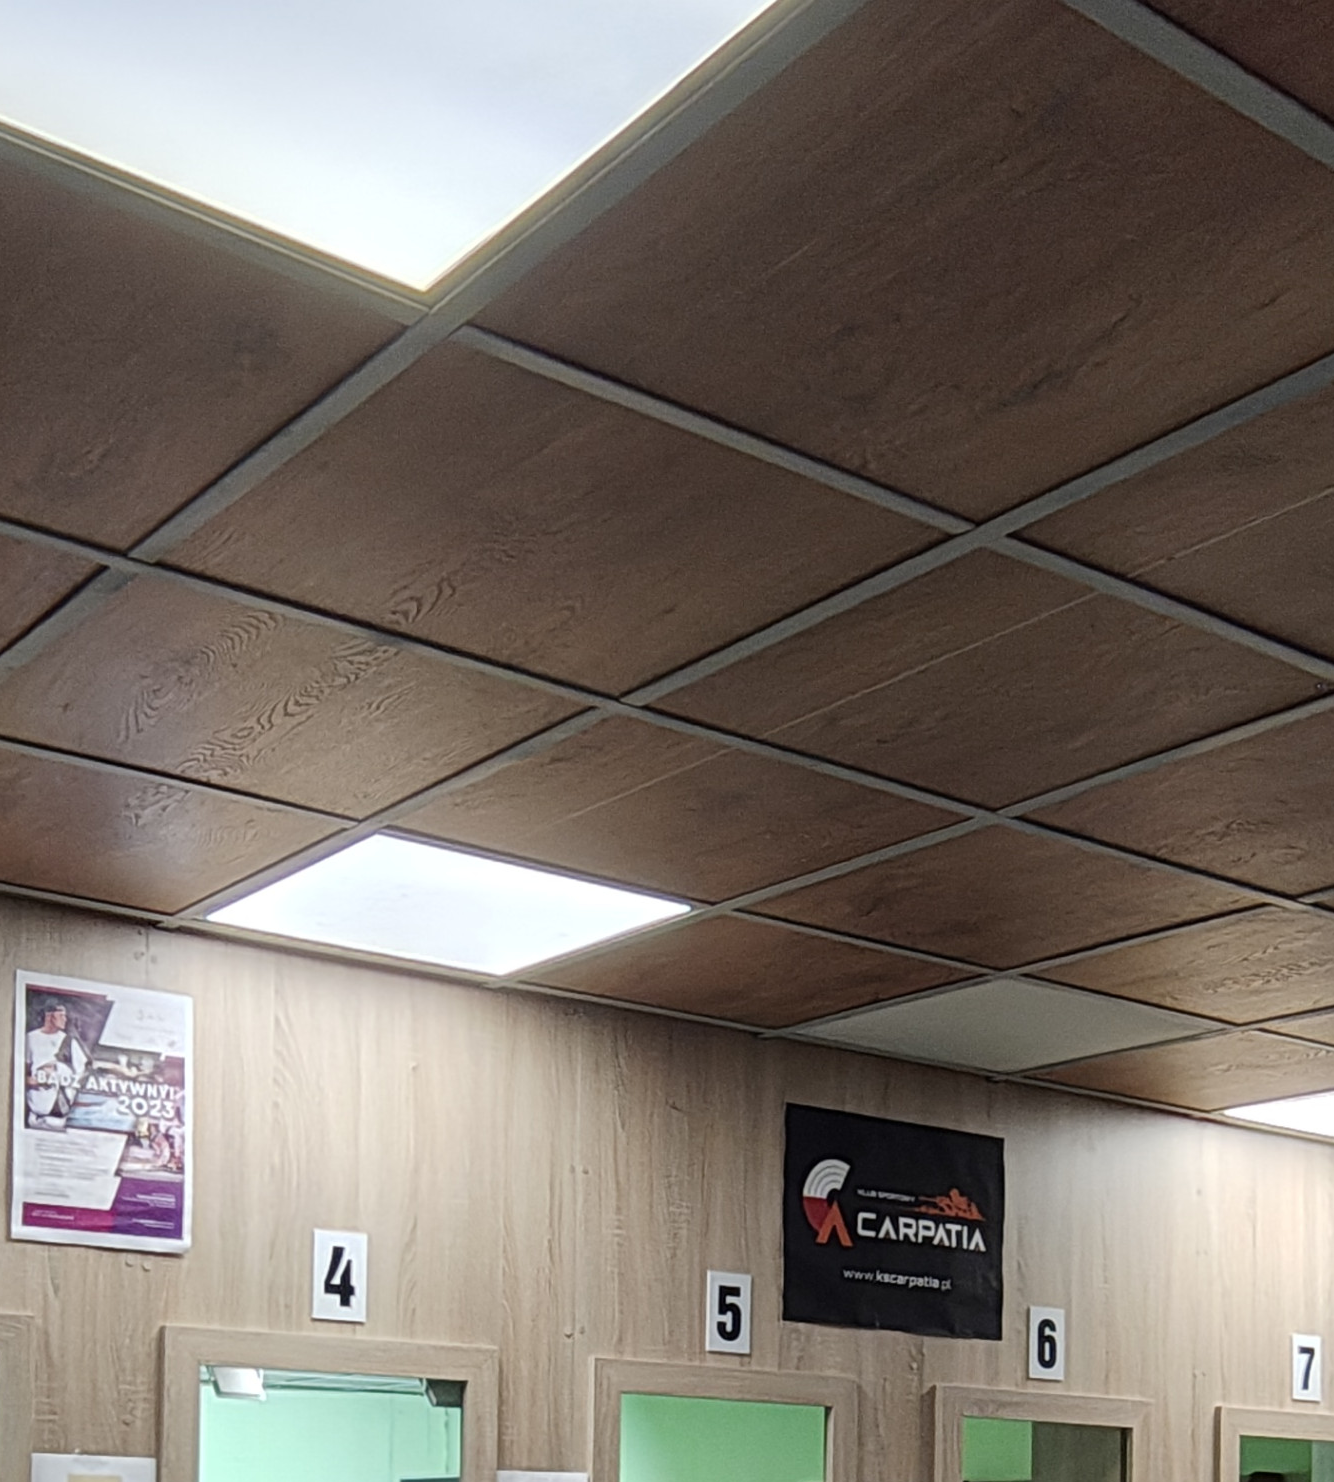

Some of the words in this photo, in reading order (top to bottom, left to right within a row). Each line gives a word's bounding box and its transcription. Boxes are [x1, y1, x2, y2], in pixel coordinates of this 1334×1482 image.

[117, 1096, 175, 1118] 2023
[856, 1211, 987, 1252] CARPATIA
[323, 1245, 356, 1308] 4
[843, 1269, 952, 1291] www.kscarpatia.pl
[716, 1284, 742, 1342] 5
[1037, 1318, 1057, 1369] 6
[1298, 1346, 1316, 1391] 7
